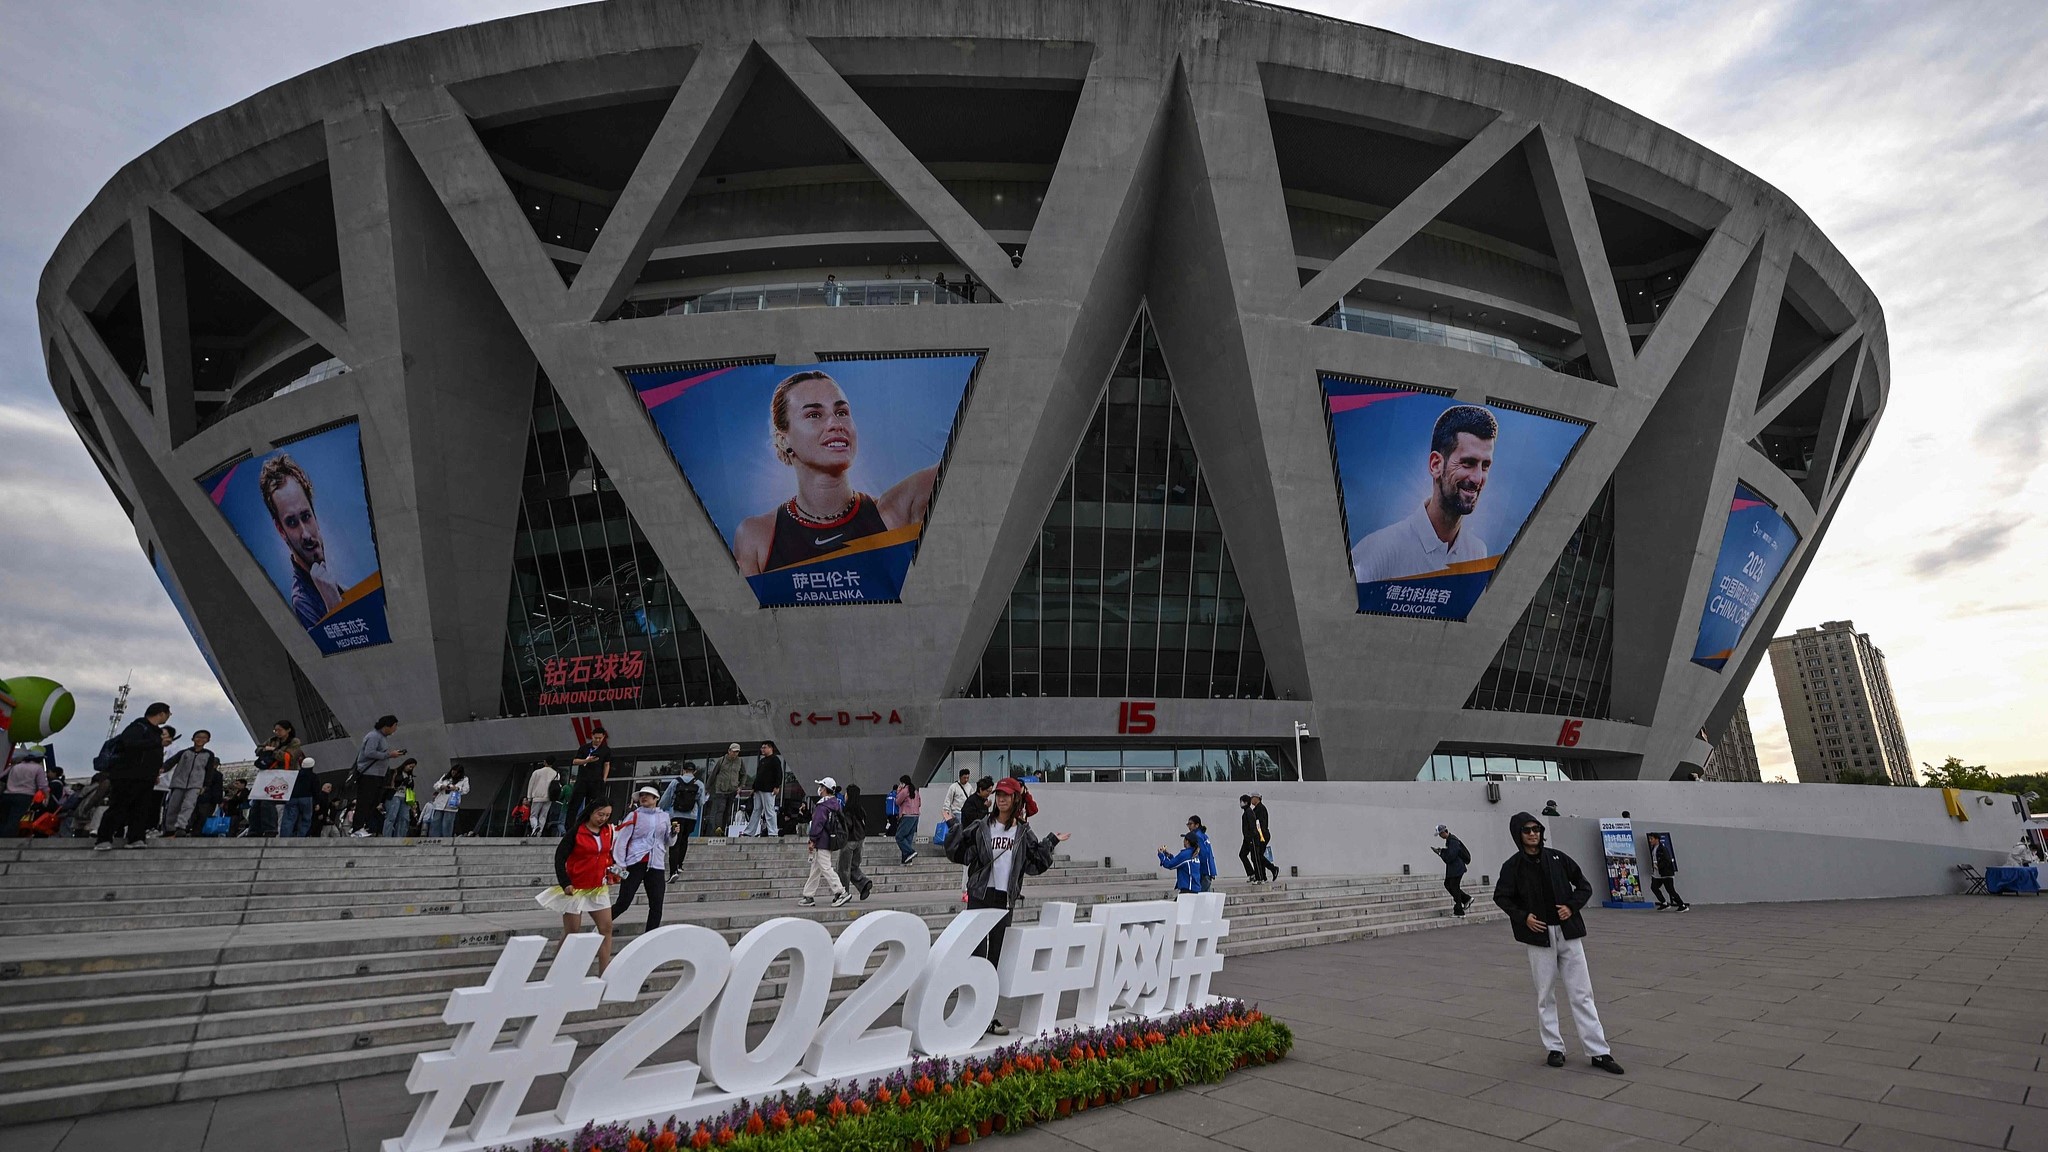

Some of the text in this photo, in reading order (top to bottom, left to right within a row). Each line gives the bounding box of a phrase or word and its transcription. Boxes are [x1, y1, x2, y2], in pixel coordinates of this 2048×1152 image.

[1743, 551, 1766, 582] 2026
[792, 571, 860, 589] 萨巴伦卡
[795, 589, 864, 601] SABALENKA
[1385, 584, 1452, 604] 德约科维奇
[1390, 603, 1437, 614] DJOKOVIC
[1710, 595, 1738, 622] CHINA
[335, 634, 369, 648] MEDVEDEV
[544, 650, 644, 686] 钻石球场
[539, 686, 641, 706] DIAMOND COURT
[789, 709, 902, 726] C D A
[1118, 702, 1156, 734] 15
[1556, 719, 1584, 747] 16
